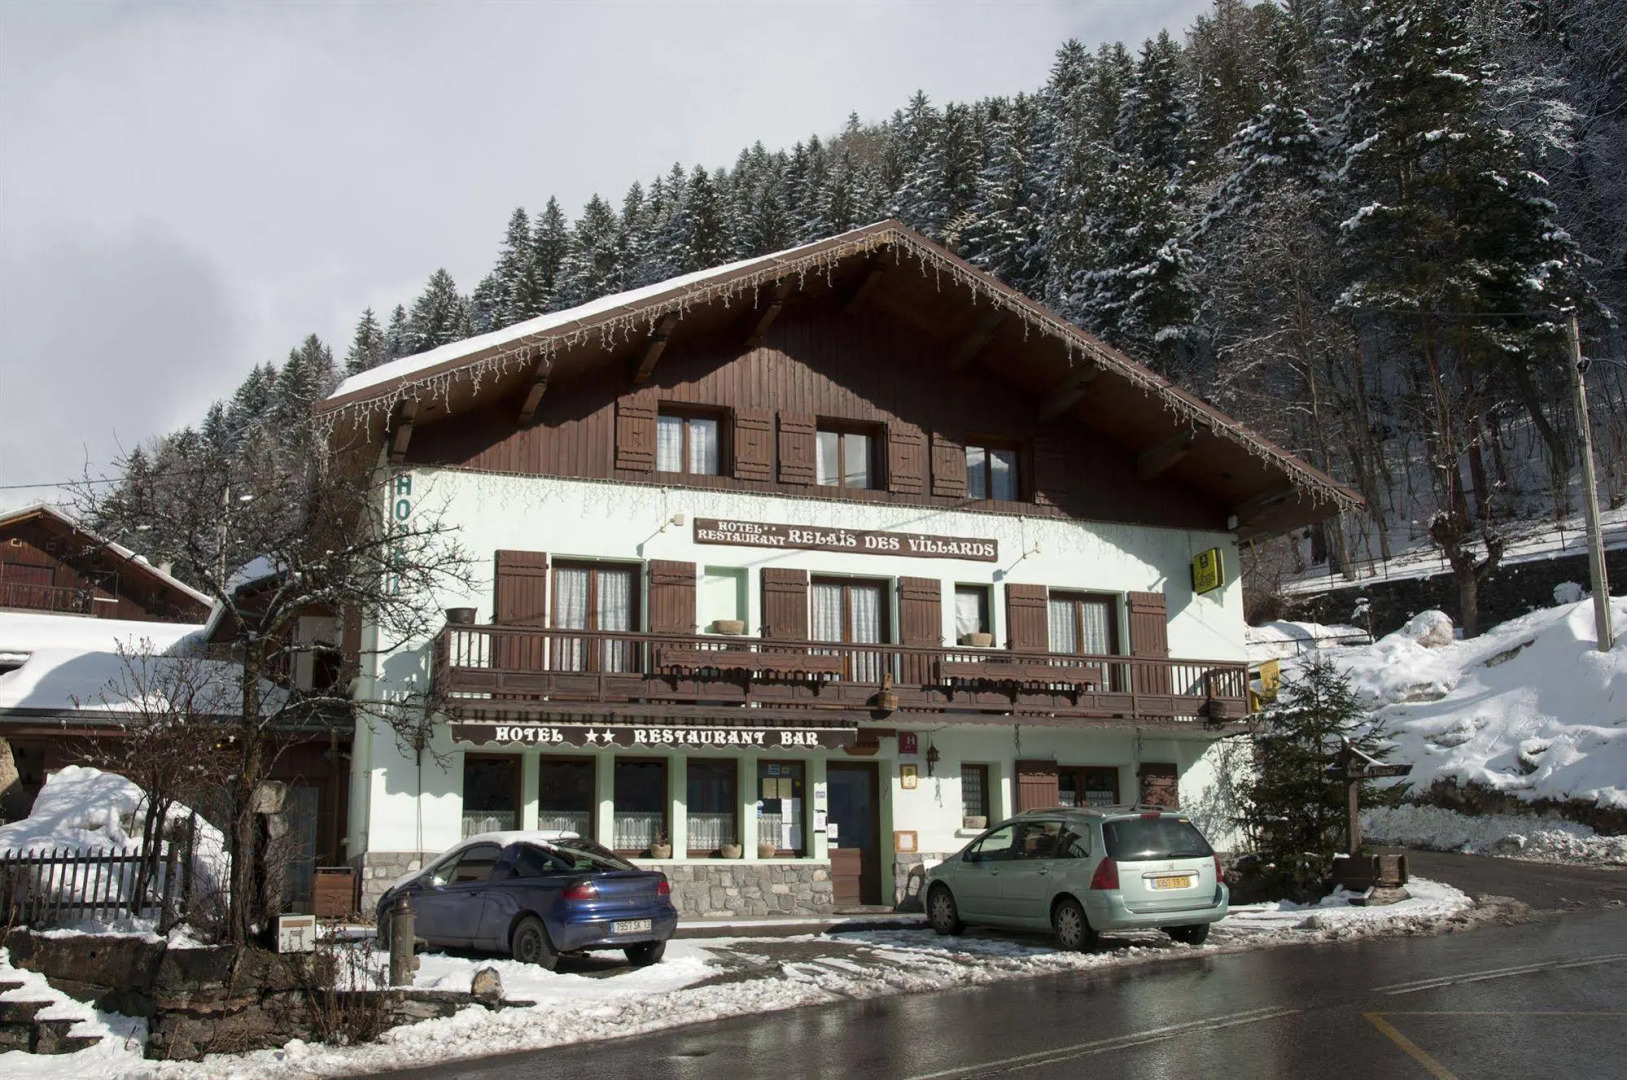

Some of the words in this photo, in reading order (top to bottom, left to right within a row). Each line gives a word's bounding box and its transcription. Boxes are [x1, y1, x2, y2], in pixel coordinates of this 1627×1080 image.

[717, 521, 763, 534] HOTEL
[697, 529, 785, 546] RESTAURANT
[864, 535, 900, 550] DES
[495, 726, 564, 742] HOTEL
[633, 729, 765, 745] RESTAURANT
[780, 731, 819, 746] BAR
